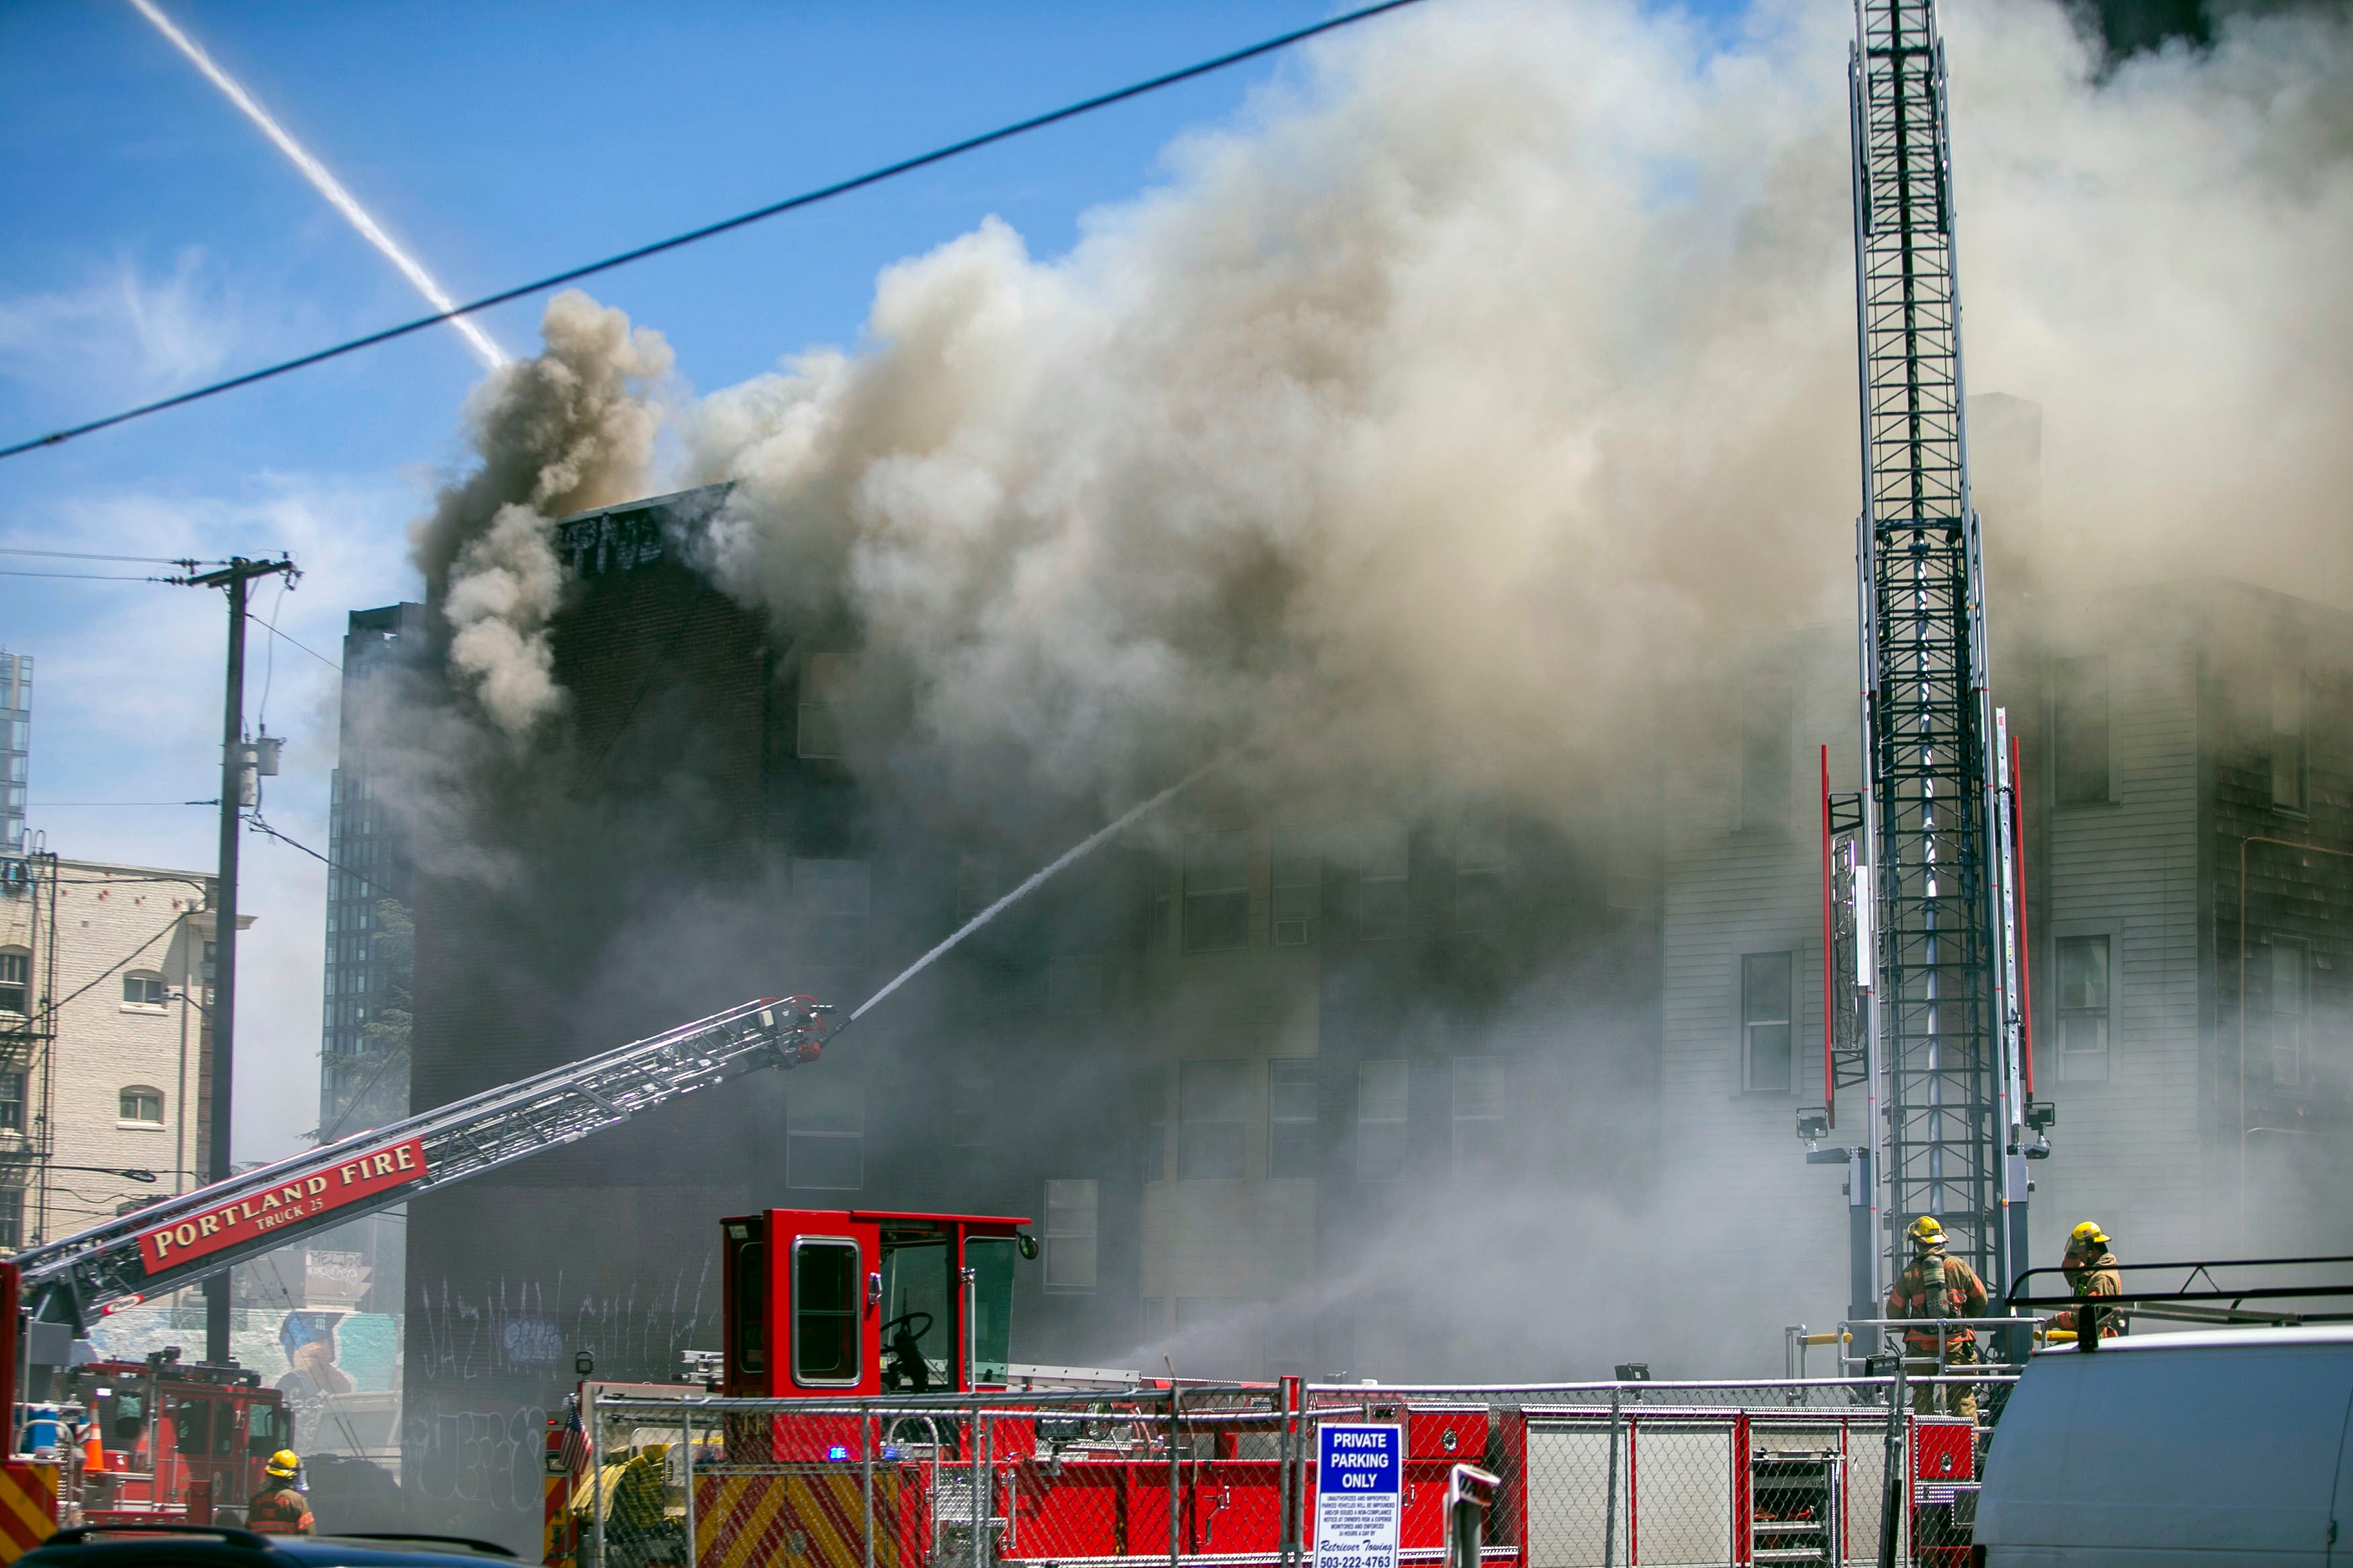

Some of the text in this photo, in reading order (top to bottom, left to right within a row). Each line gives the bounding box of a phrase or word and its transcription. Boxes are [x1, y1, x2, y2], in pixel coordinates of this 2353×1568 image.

[153, 1144, 415, 1260] PORTLAND FIRE
[255, 1198, 324, 1231] TRUCK 25
[1334, 1433, 1387, 1448] PRIVATE
[1330, 1453, 1389, 1468] PARKING
[1342, 1473, 1378, 1488] ONLY
[1320, 1539, 1392, 1555] Retriever Towing
[1320, 1556, 1390, 1568] 503-222-4763
